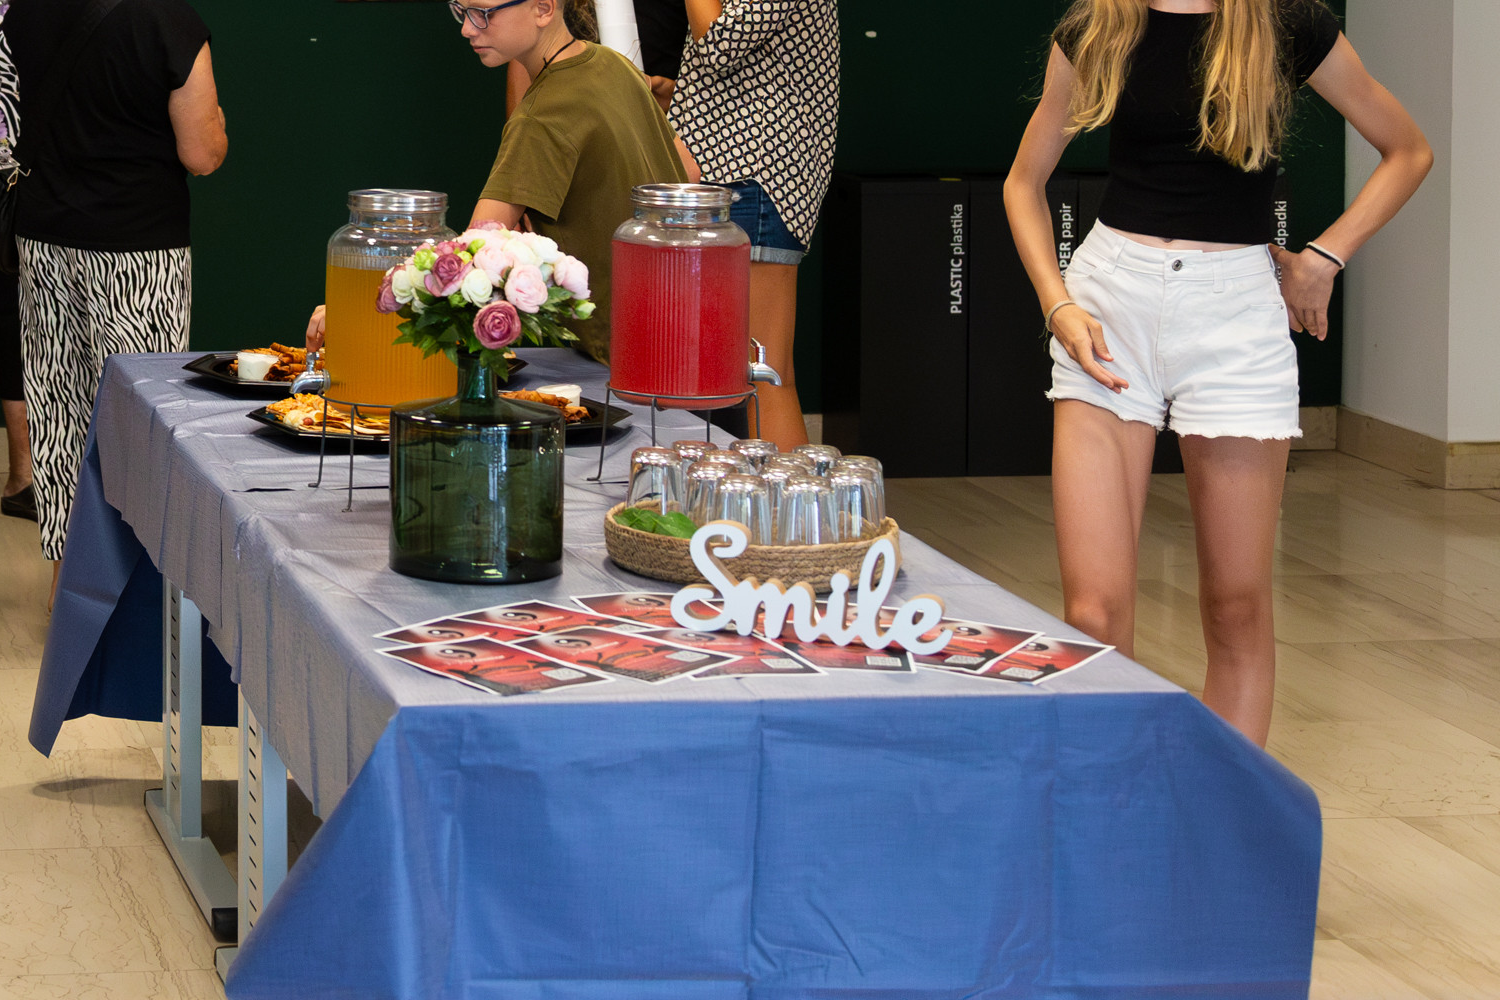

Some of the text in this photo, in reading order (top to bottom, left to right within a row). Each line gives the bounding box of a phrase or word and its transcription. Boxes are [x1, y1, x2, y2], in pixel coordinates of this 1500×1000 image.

[950, 204, 965, 314] PLASTIC plastika
[1059, 203, 1074, 280] APER papir
[670, 520, 954, 656] Smile
